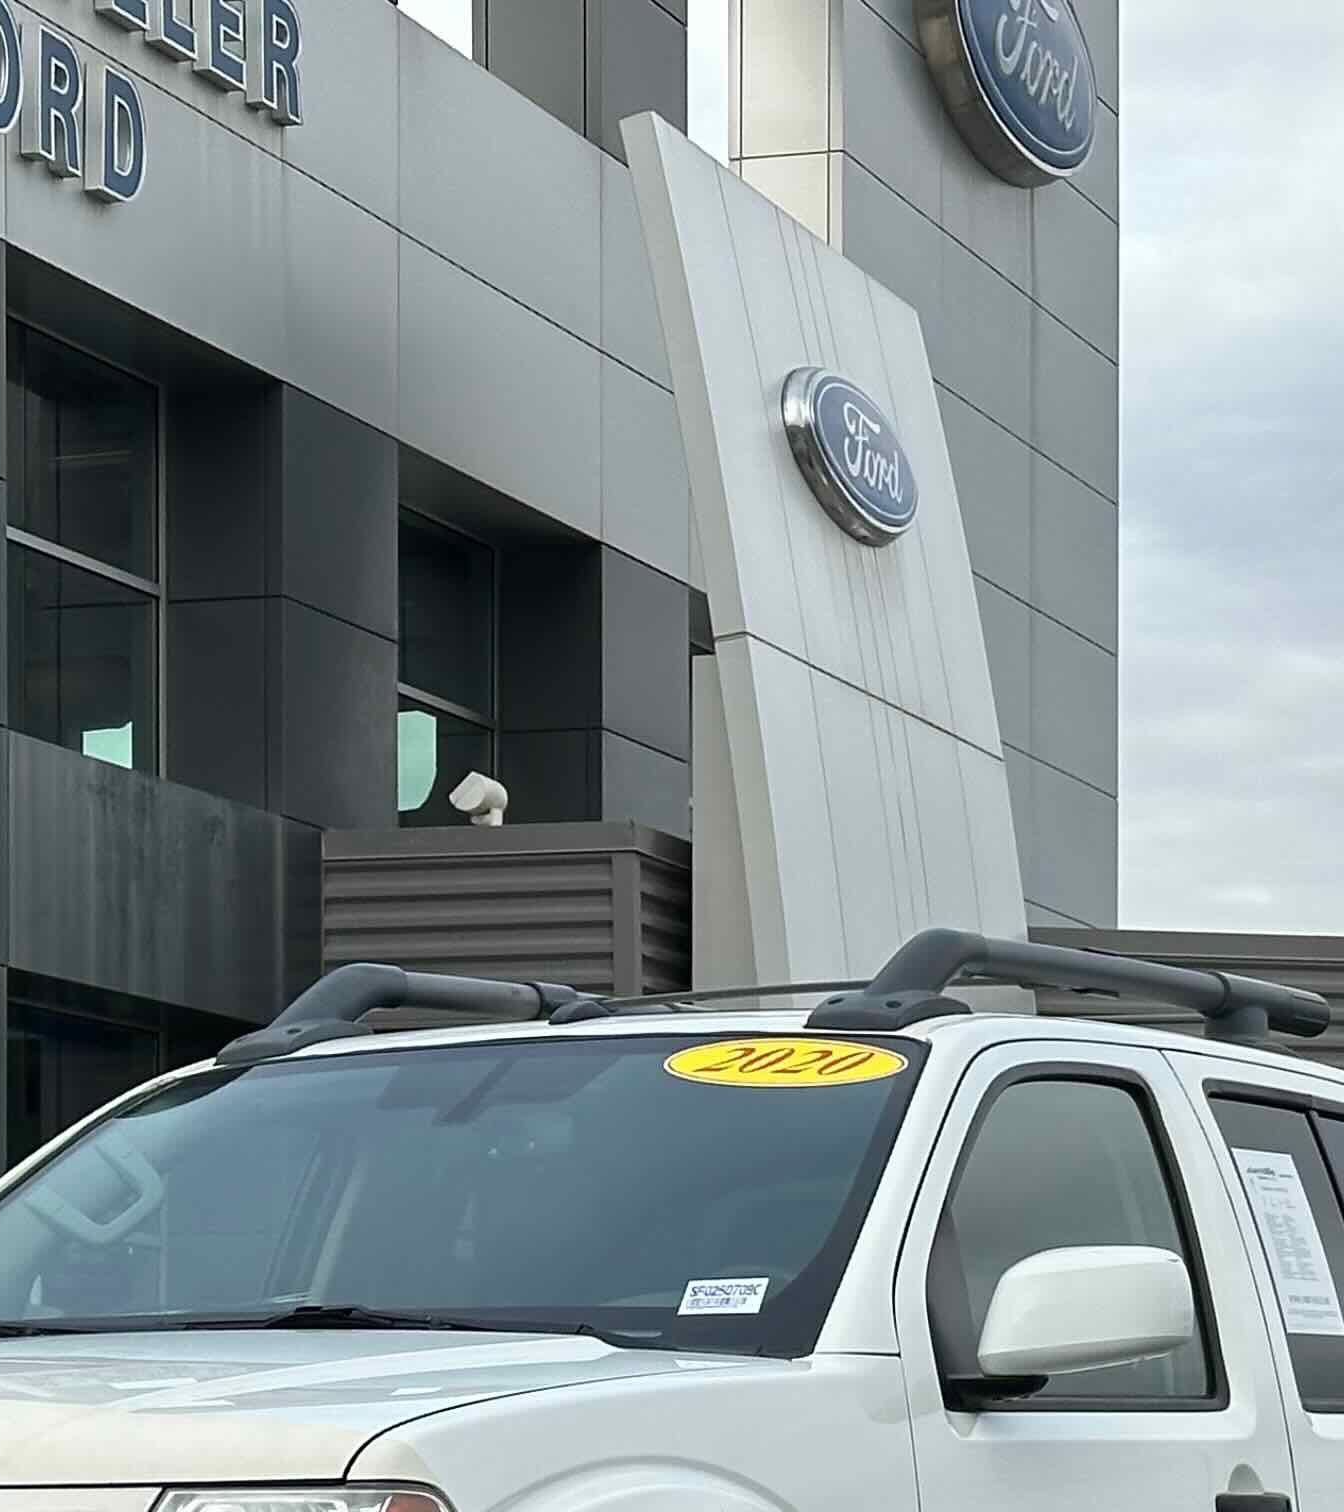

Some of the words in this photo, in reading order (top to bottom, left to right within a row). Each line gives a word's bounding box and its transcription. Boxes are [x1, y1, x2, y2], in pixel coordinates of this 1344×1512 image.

[996, 0, 1078, 131] Ford
[844, 402, 903, 503] Ford
[692, 1047, 875, 1076] 2020
